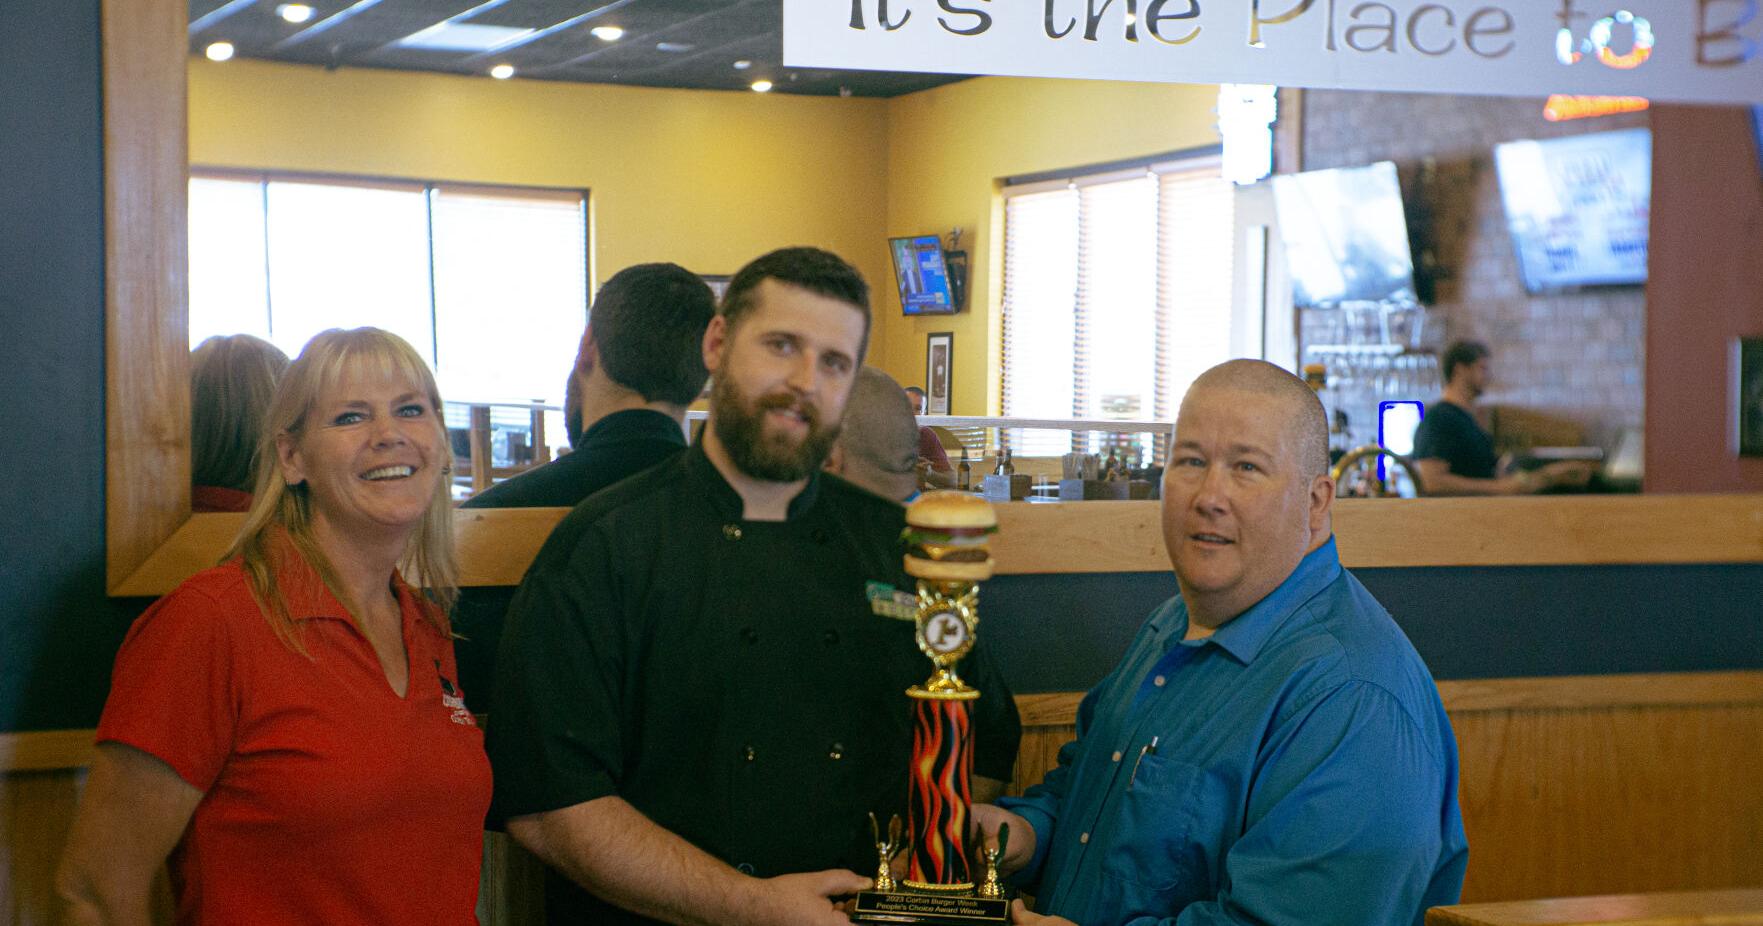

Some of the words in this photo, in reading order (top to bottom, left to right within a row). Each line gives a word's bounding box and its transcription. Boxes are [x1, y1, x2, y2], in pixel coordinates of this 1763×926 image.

[1248, 0, 1516, 58] Place
[1556, 0, 1655, 70] to
[876, 902, 907, 911] People's
[908, 904, 934, 912] Choice
[935, 905, 958, 913] Award
[960, 907, 986, 915] Winner
[931, 898, 955, 906] Burger
